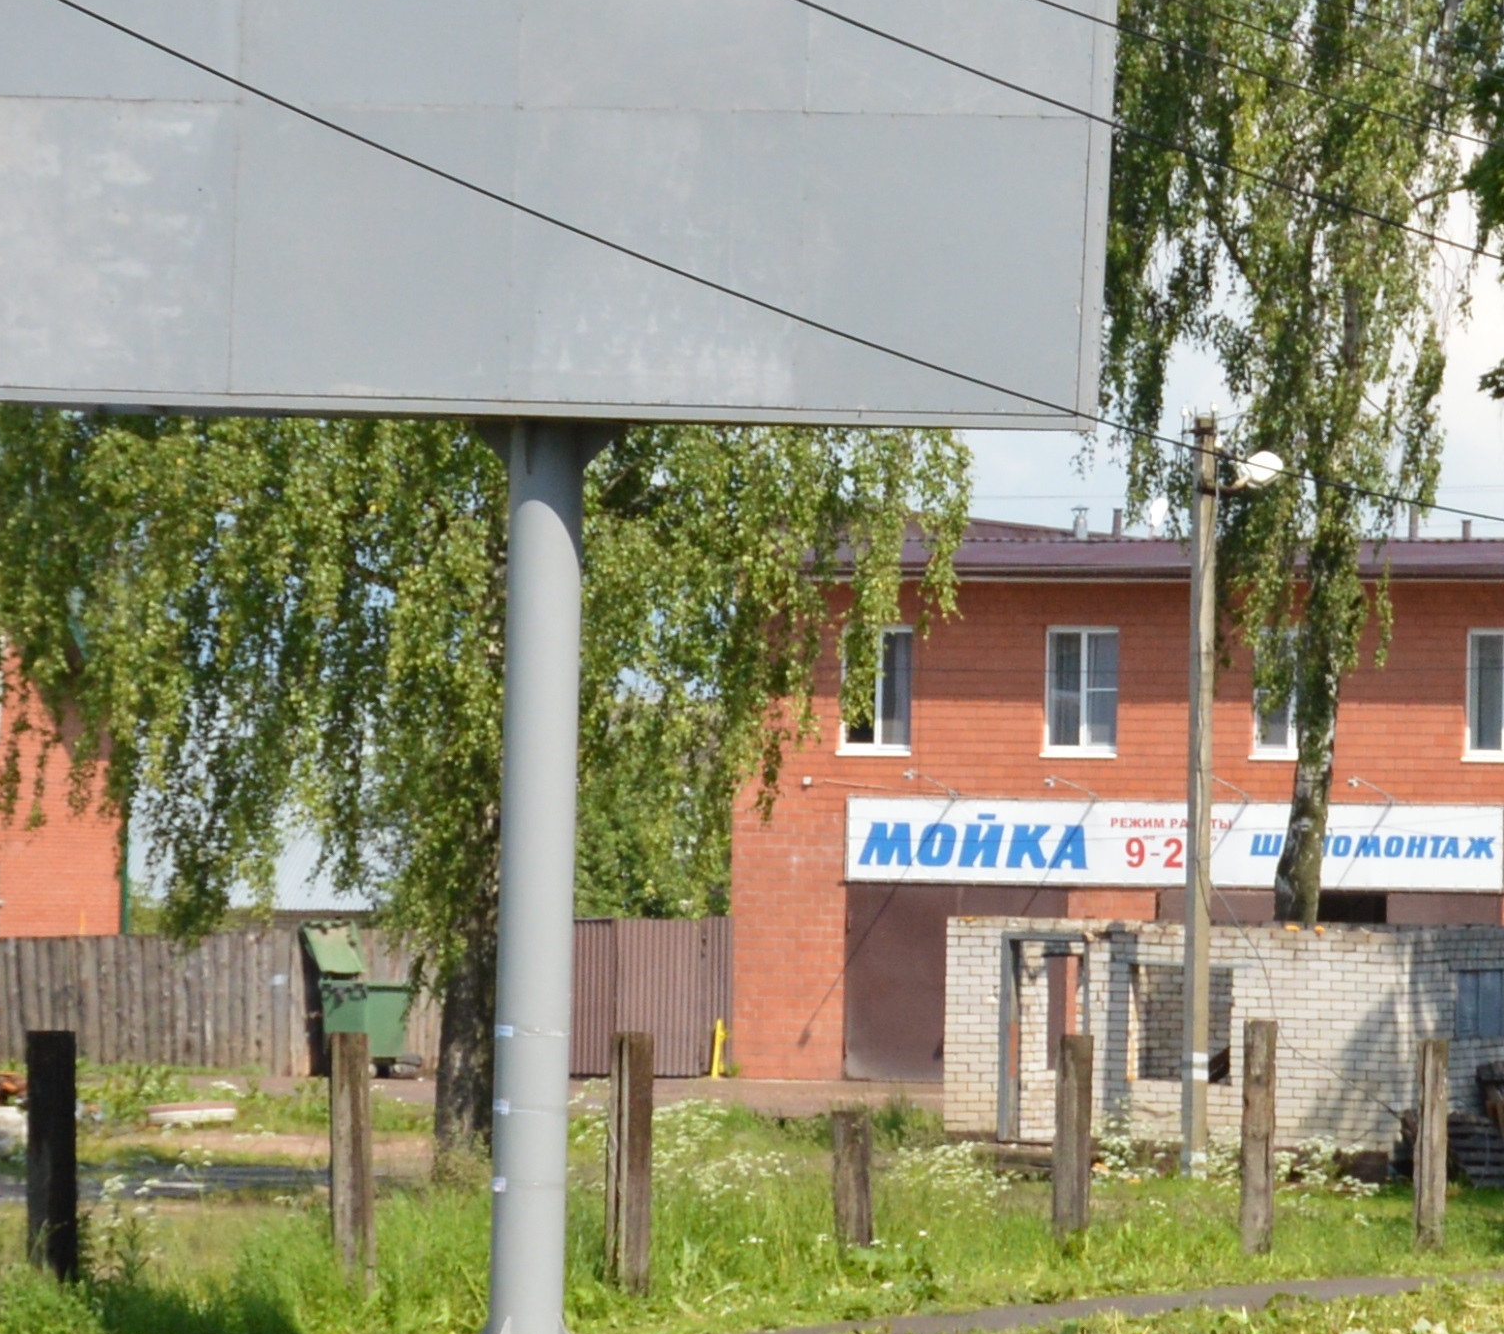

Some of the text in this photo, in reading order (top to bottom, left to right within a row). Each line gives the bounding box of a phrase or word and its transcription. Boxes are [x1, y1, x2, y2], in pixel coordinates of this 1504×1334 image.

[1110, 817, 1233, 830] РЕЖИМ РАТЫ
[858, 813, 1088, 870] МОЙКА
[1250, 833, 1496, 860] ШОМОНТАЖ
